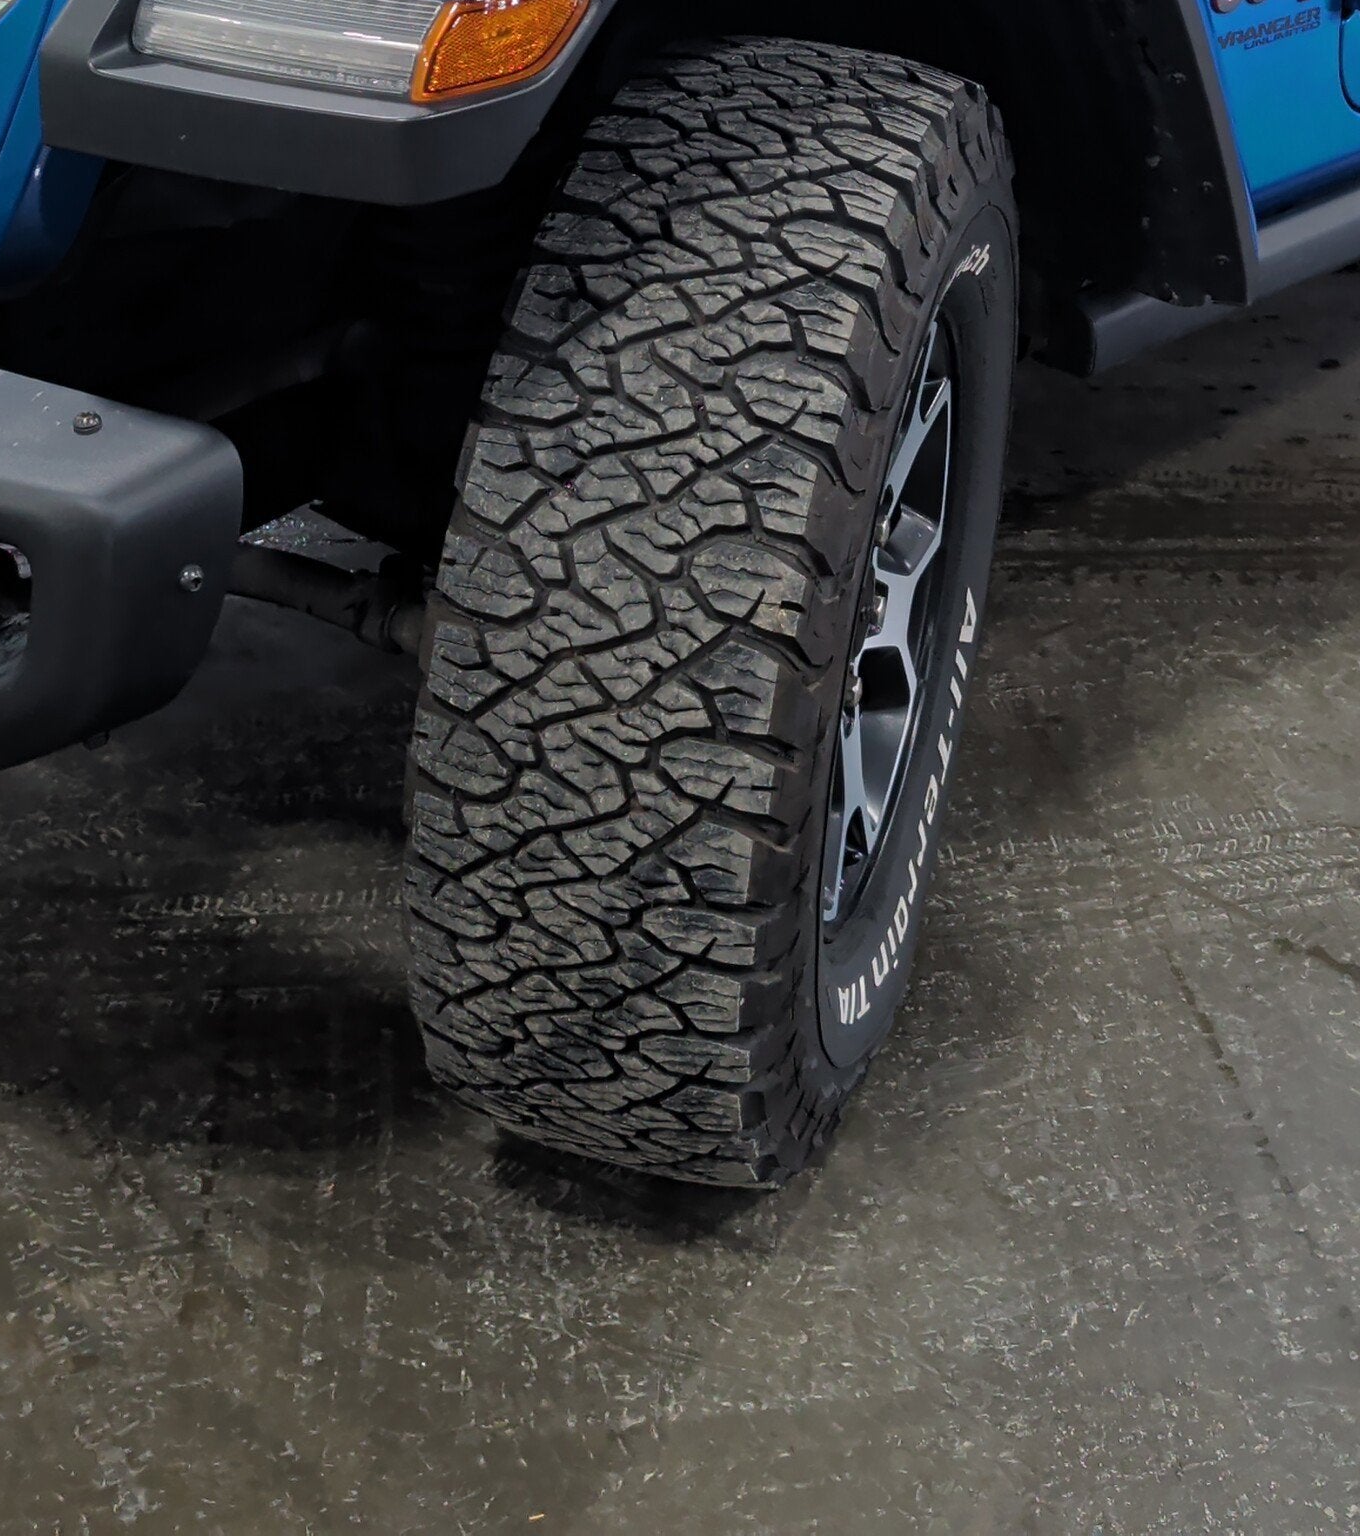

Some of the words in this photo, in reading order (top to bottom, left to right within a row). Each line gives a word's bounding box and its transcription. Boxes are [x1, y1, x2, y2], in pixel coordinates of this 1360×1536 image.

[1217, 6, 1321, 49] WRANGLER
[871, 587, 978, 987] All-Terrain
[838, 975, 871, 1024] T/A
